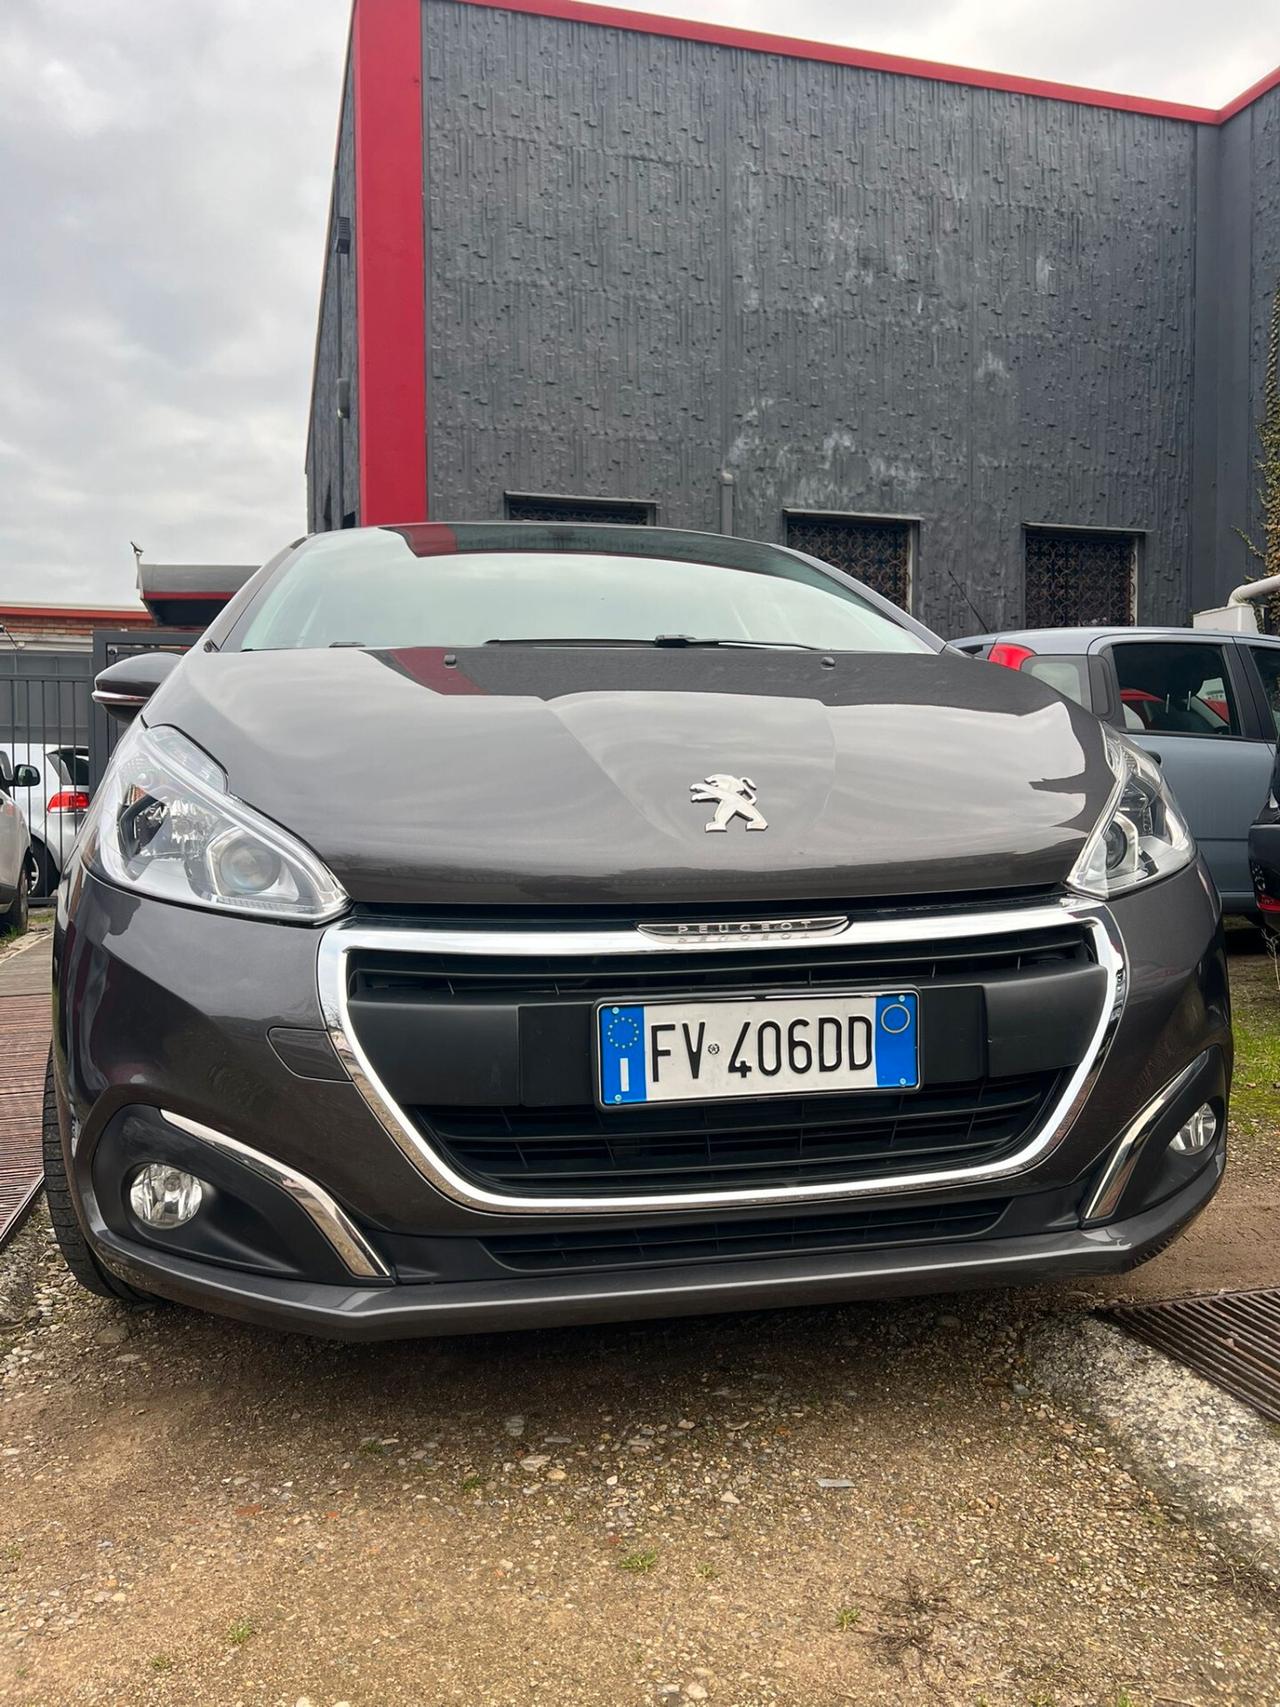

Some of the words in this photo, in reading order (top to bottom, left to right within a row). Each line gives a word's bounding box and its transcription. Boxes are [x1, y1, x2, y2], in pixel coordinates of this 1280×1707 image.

[678, 920, 811, 934] PEUGEOT
[651, 1021, 706, 1082] FV
[727, 1015, 873, 1078] 406DD
